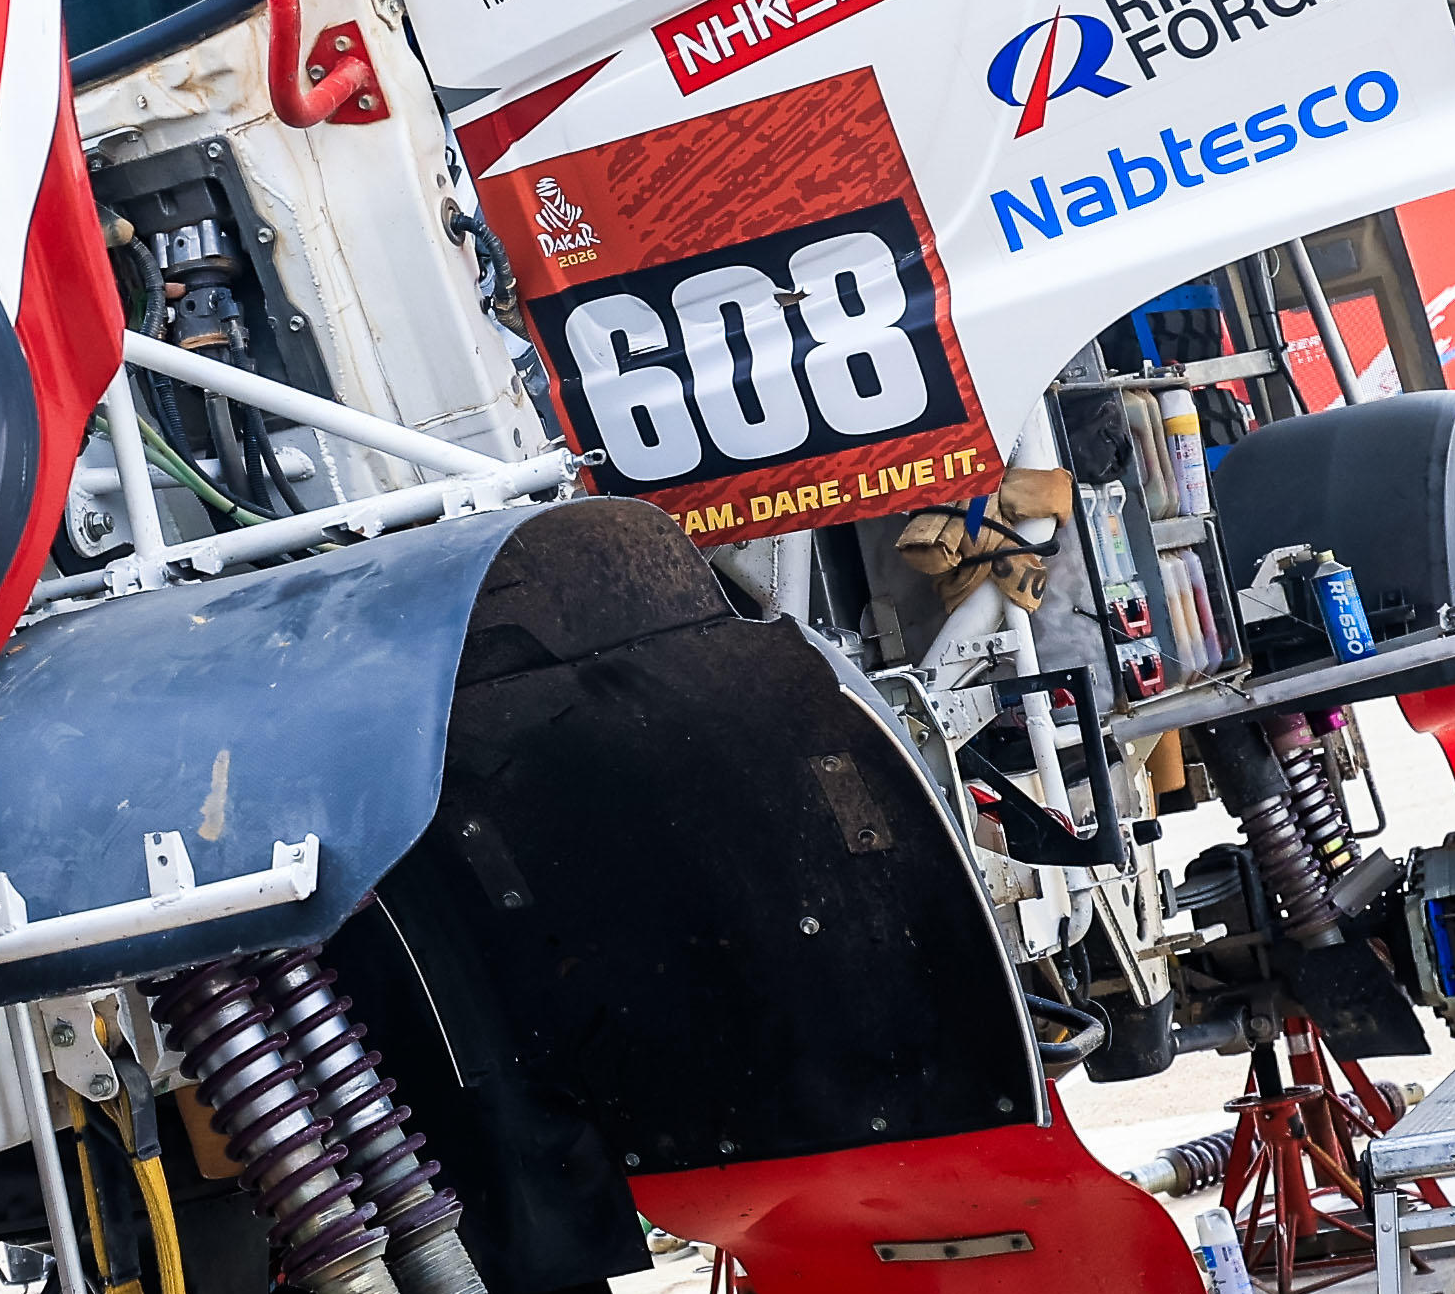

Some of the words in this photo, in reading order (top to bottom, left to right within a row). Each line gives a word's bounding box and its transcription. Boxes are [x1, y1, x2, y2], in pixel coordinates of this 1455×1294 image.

[990, 69, 1401, 252] Nabtesco
[538, 221, 602, 259] DAKAR
[557, 248, 599, 269] 2026
[565, 232, 930, 481] 608
[679, 499, 743, 536] EAM.
[751, 480, 853, 522] DARE.
[858, 456, 936, 498] LIVE
[943, 445, 987, 481] IT.
[1327, 580, 1365, 655] RF-650
